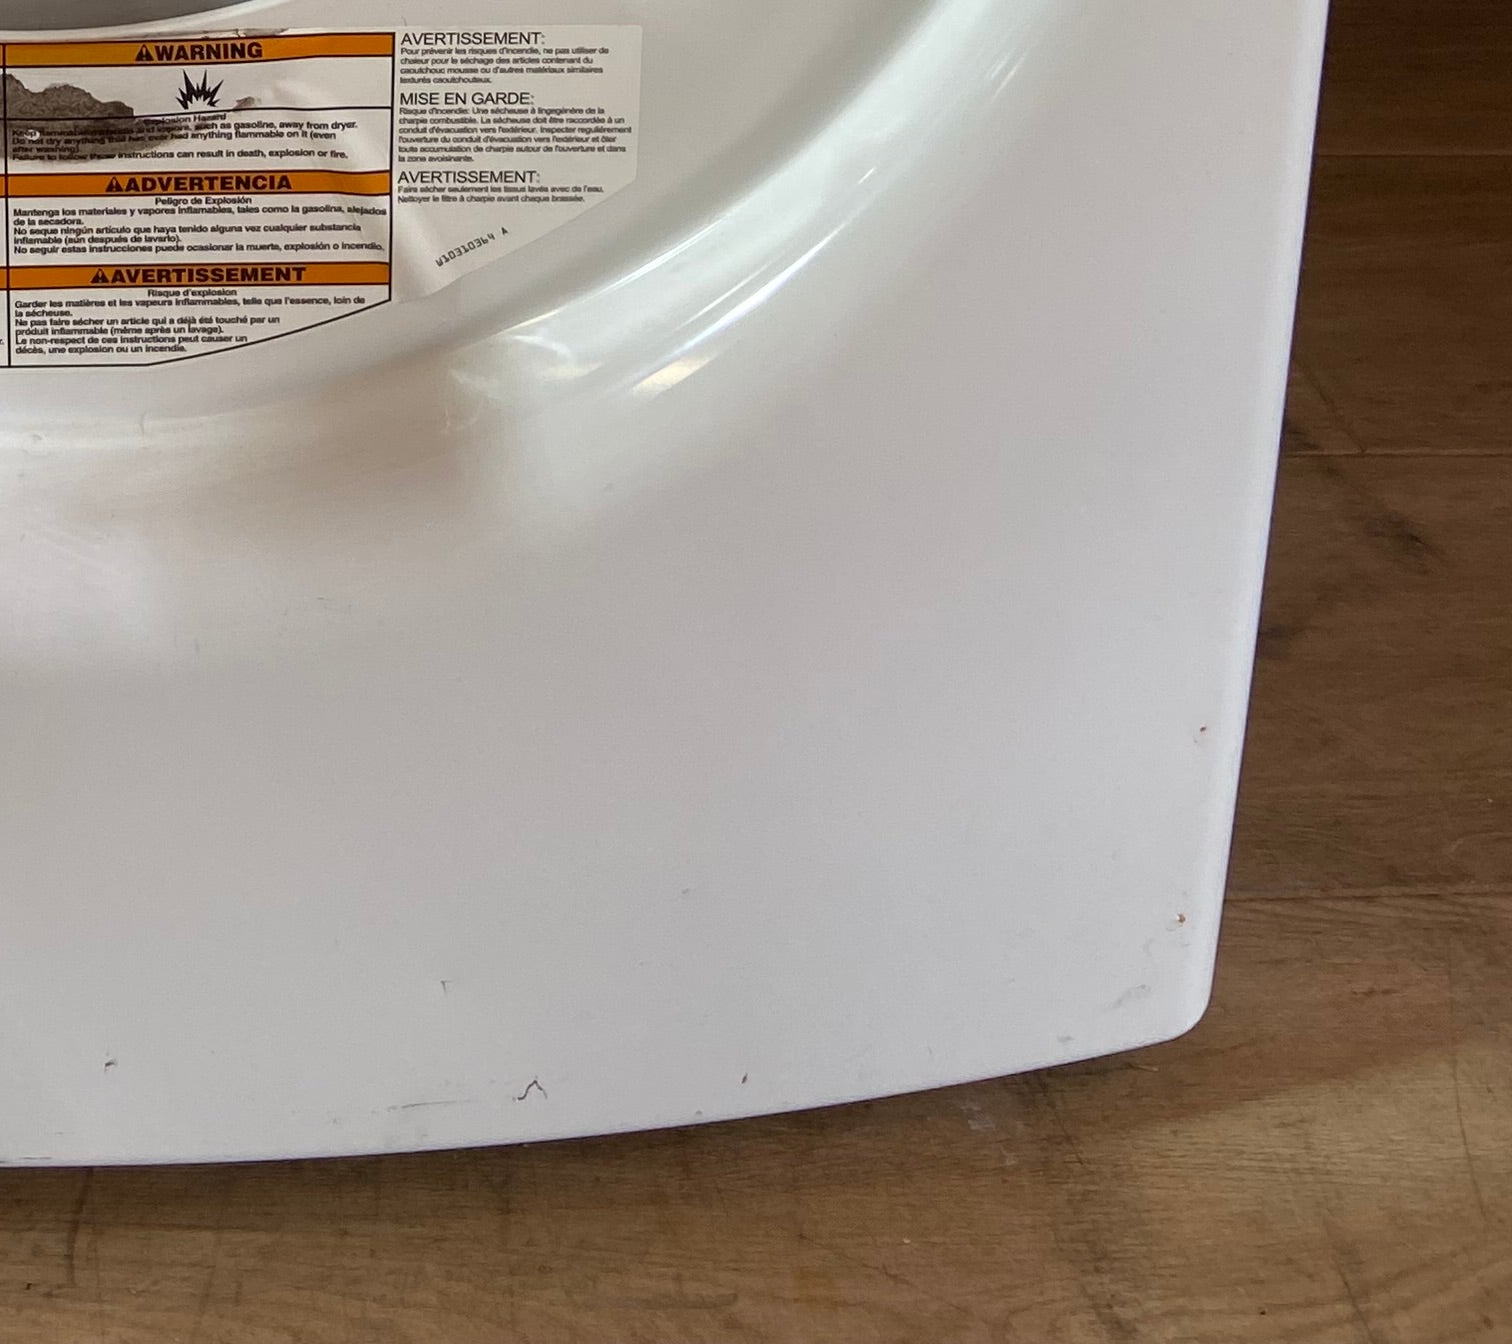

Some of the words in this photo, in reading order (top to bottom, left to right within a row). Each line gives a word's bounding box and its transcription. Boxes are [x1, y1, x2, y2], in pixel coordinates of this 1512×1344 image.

[401, 32, 546, 46] AVERTISSEMENT:
[154, 42, 263, 61] WARNING
[399, 92, 440, 105] MISE
[444, 92, 467, 105] EN
[471, 92, 535, 105] GARDE:
[125, 175, 293, 192] ADVERTENCIA
[398, 171, 541, 184] AVERTISSEMENT:
[155, 197, 188, 207] Peligro
[190, 197, 203, 205] de
[205, 196, 252, 207] Explosión
[111, 266, 307, 284] AVERTISSEMENT
[147, 289, 180, 298] Risque
[183, 288, 237, 298] d'explosion
